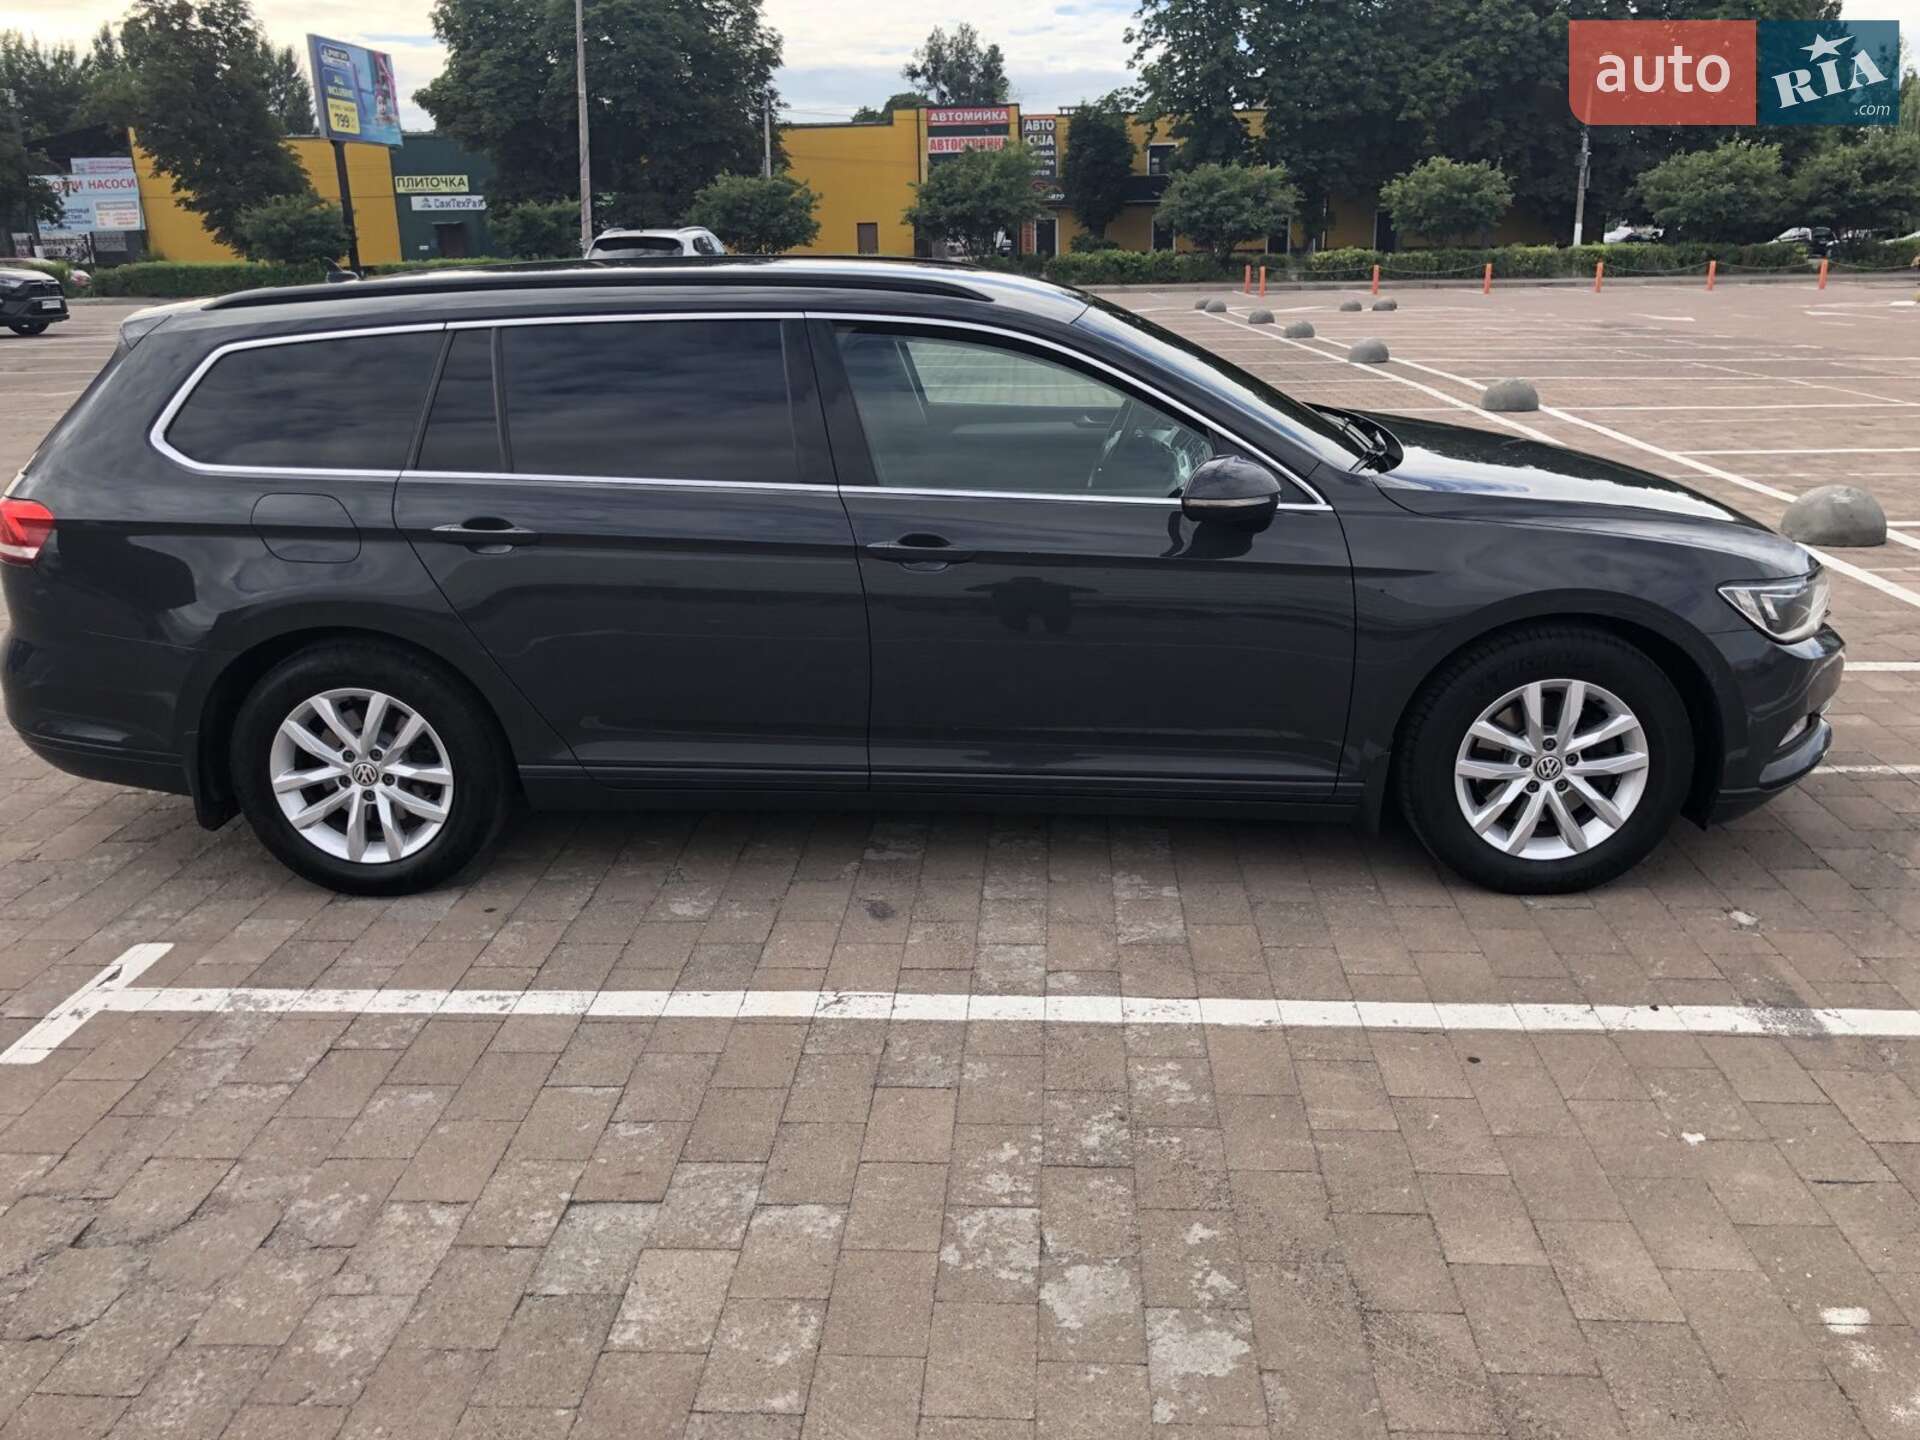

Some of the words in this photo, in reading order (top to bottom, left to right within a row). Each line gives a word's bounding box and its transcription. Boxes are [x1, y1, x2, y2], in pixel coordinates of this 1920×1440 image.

[1024, 119, 1055, 131] АВТО
[88, 178, 137, 190] НАСОСИ
[396, 176, 467, 189] ПЛИТОЧКА
